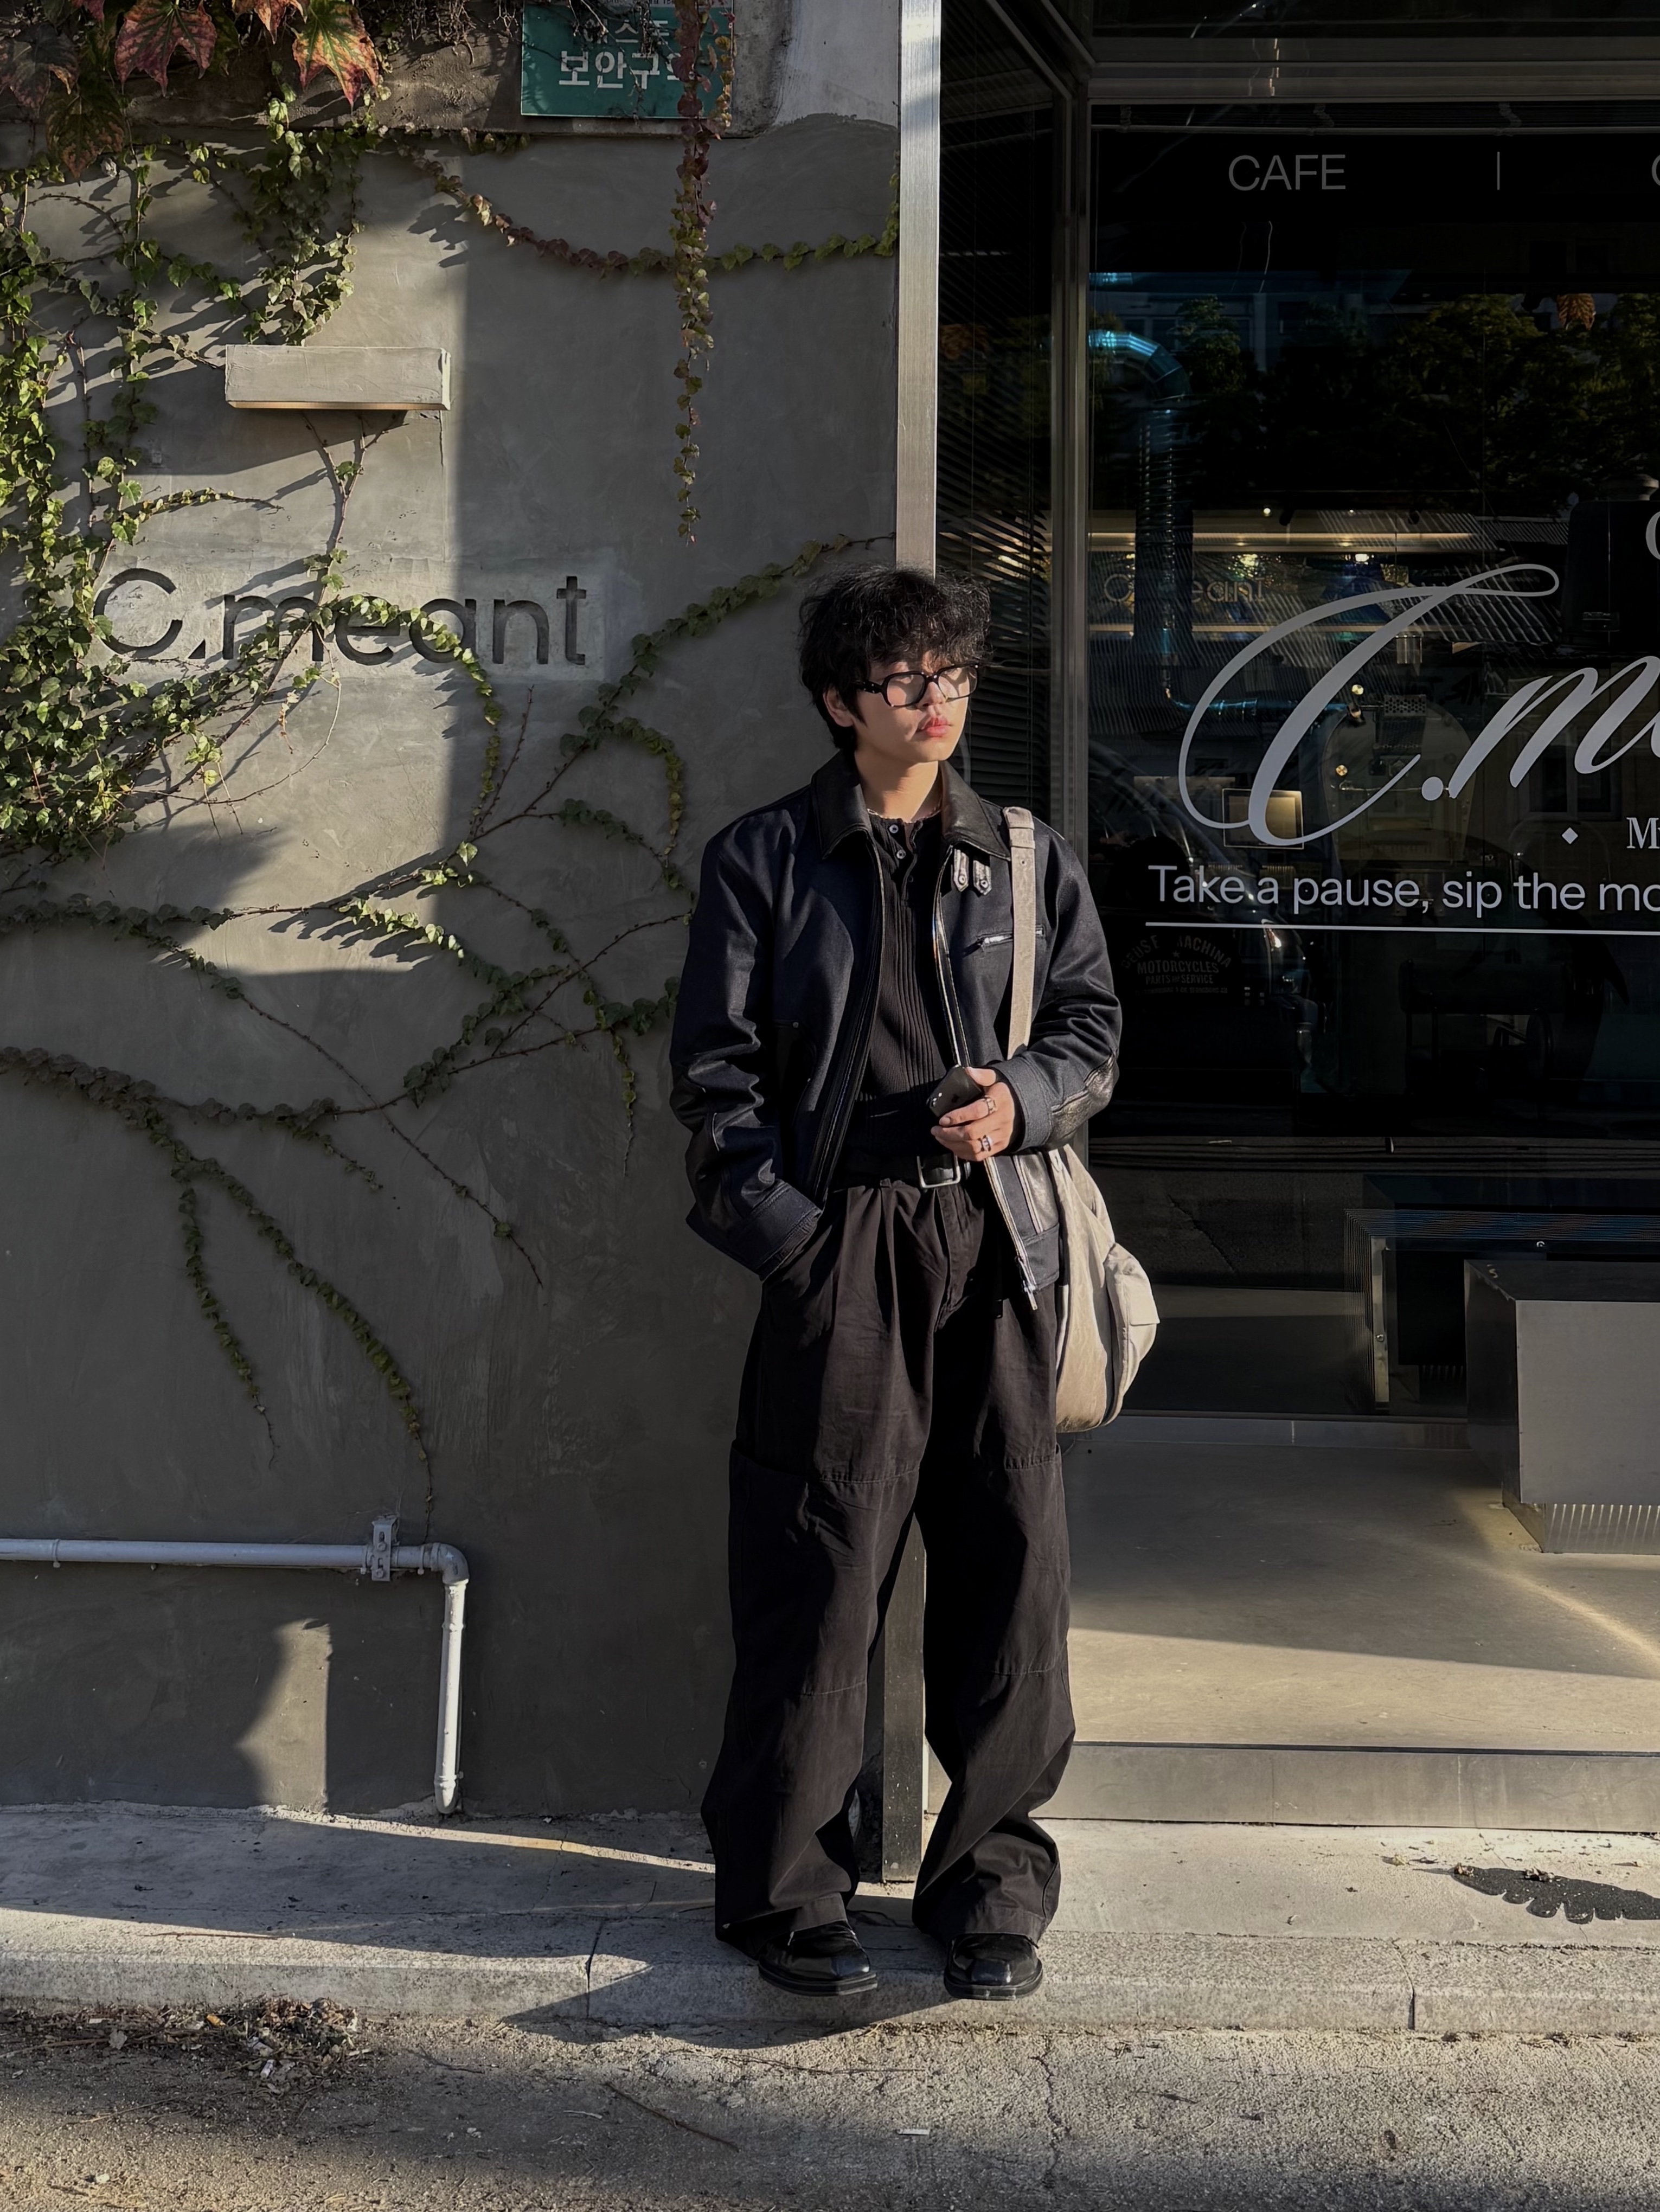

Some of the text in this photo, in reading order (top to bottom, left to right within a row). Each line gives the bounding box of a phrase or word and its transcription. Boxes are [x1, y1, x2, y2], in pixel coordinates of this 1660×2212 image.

[558, 50, 682, 90] 보안구
[1228, 154, 1347, 191] CAFE
[1626, 817, 1660, 850] M
[1148, 865, 1246, 903] Take
[1257, 877, 1279, 904] a
[1294, 878, 1429, 915] pause,
[1443, 871, 1502, 918] sip
[1513, 872, 1585, 910] the
[1137, 959, 1220, 975] MOTORCYCLES
[1145, 974, 1171, 985] PARTS
[1181, 974, 1214, 984] SERVICE
